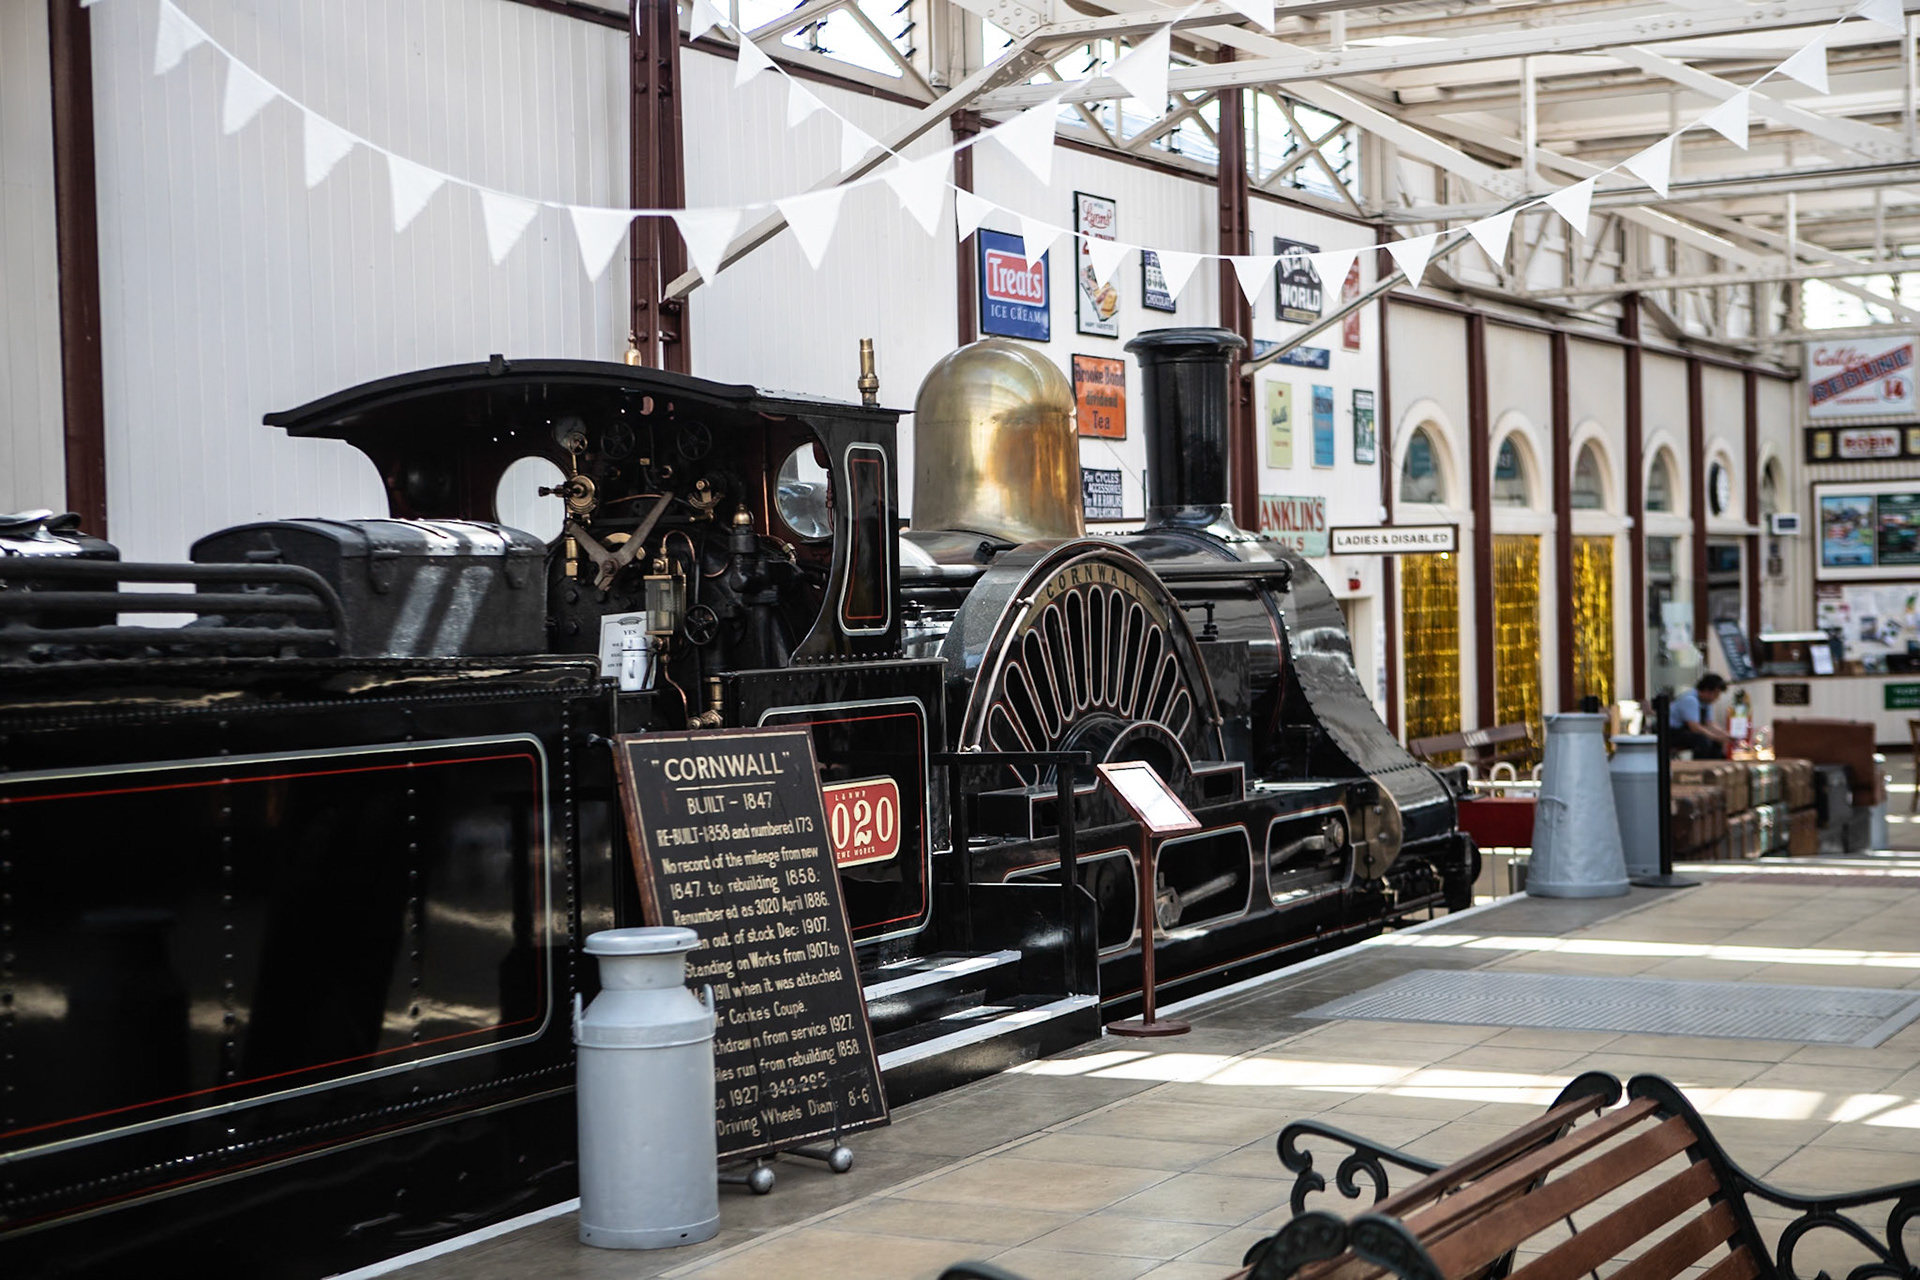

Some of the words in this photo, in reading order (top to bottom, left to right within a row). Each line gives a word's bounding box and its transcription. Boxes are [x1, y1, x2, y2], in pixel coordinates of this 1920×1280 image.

[989, 257, 1042, 299] Treats
[1280, 283, 1320, 311] WORLD
[990, 304, 1007, 319] ICE
[1010, 306, 1042, 323] CREAM
[1074, 363, 1103, 384] Brooke
[1105, 366, 1125, 387] Bond
[1811, 347, 1910, 402] REDLINE
[1093, 410, 1110, 429] Tea
[1095, 471, 1120, 484] CYCLES
[1260, 498, 1325, 533] ANKLIN'S
[1337, 535, 1379, 546] LADIES
[1381, 535, 1389, 544] &
[1391, 533, 1449, 544] DISABLED
[1046, 564, 1141, 599] CORNWALL
[687, 795, 725, 815] BUILT
[743, 791, 773, 810] 1847
[731, 823, 750, 839] and
[750, 819, 795, 838] numbered
[795, 816, 814, 833] 173
[831, 796, 894, 850] 020
[661, 858, 677, 875] No
[677, 855, 711, 873] record
[711, 853, 724, 869] of
[725, 851, 744, 867] the
[744, 849, 780, 869] mileage
[780, 846, 801, 861] from
[801, 847, 819, 859] new
[837, 851, 851, 860] EWE
[854, 846, 876, 856] WORKS
[707, 881, 723, 895] to
[727, 873, 780, 894] rebuilding
[672, 904, 739, 926] Renumbered
[741, 905, 754, 917] as
[754, 896, 780, 915] 3020
[781, 895, 803, 915] April
[803, 891, 830, 909] 1886.
[734, 928, 745, 944] of
[747, 925, 776, 942] stock
[801, 916, 830, 935] 1907.
[684, 960, 735, 979] Standing
[736, 958, 750, 970] on
[748, 951, 781, 969] Works
[783, 947, 806, 964] from
[829, 943, 840, 956] to
[713, 983, 731, 1001] 1911
[732, 981, 762, 998] when
[762, 977, 774, 992] it
[774, 977, 795, 991] was
[796, 966, 843, 987] attached
[728, 1006, 771, 1025] Cooke's
[762, 1030, 789, 1047] from
[790, 1021, 827, 1041] service
[828, 1013, 855, 1034] 1927.
[736, 1064, 757, 1078] run
[759, 1057, 786, 1074] from
[787, 1046, 837, 1068] rebuilding
[729, 1085, 759, 1107] 1927
[716, 1116, 761, 1137] Driving
[760, 1104, 803, 1126] Wheels
